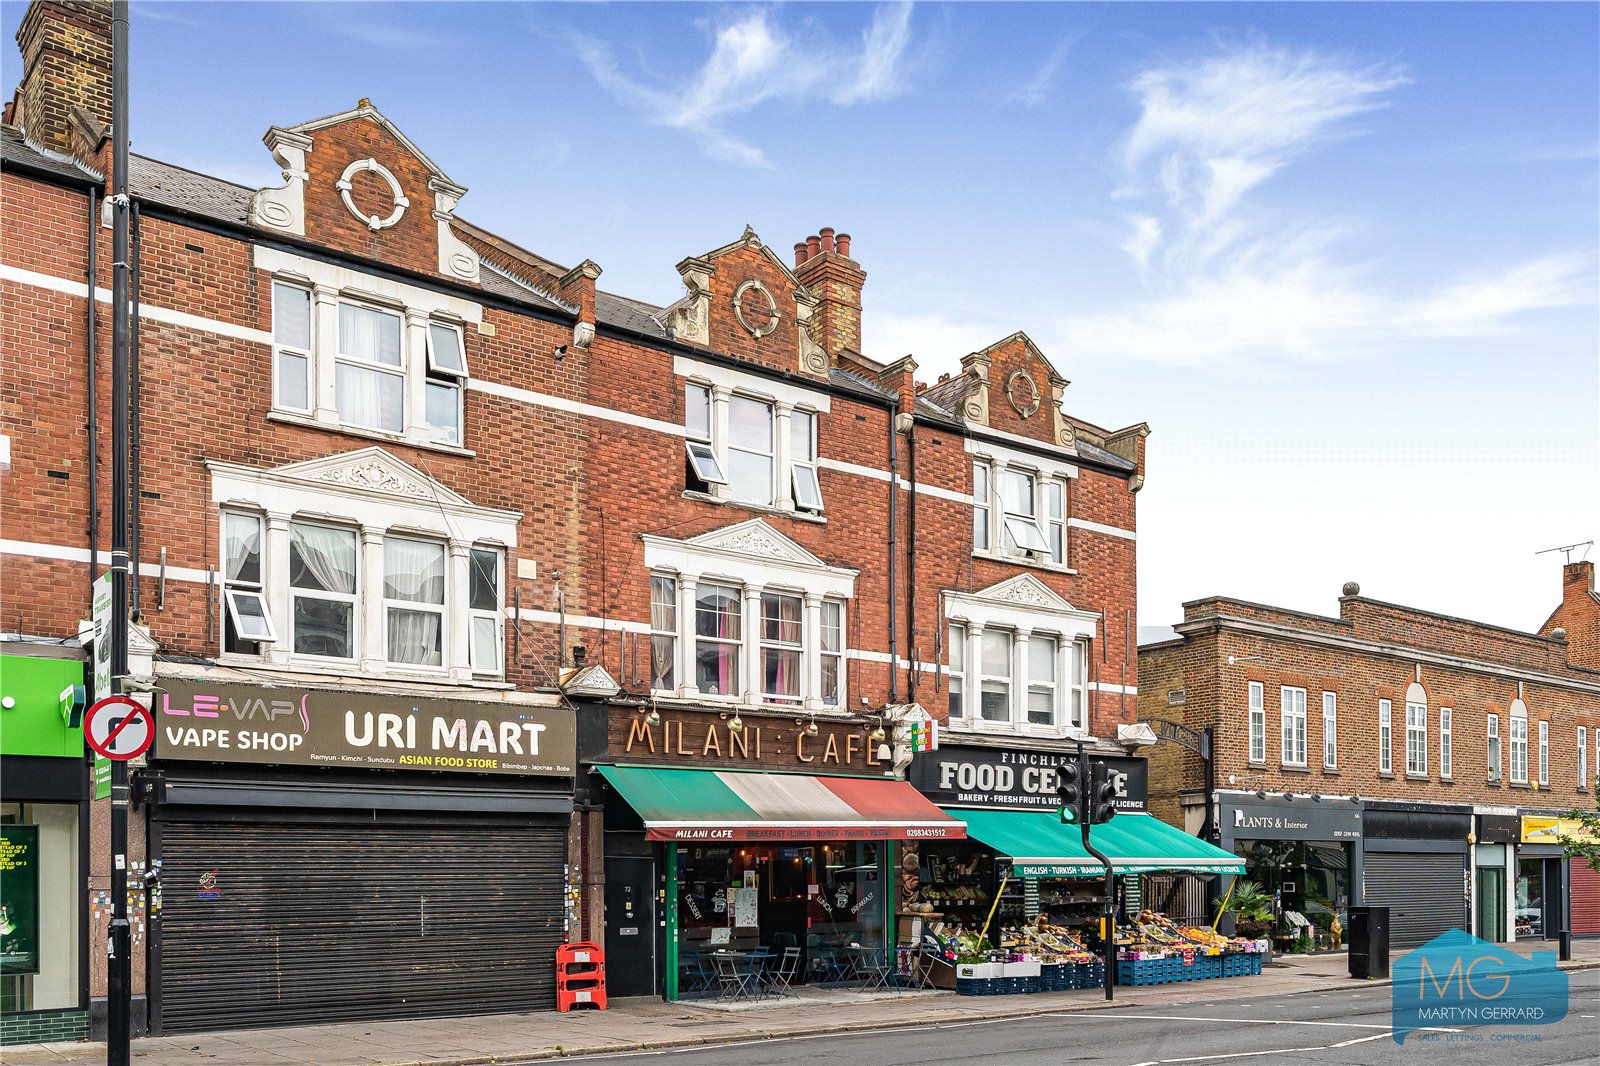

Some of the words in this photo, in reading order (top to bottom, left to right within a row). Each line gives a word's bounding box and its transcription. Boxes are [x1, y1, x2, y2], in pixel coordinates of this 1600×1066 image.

[166, 726, 231, 749] VAPE
[237, 730, 303, 752] SHOP
[345, 709, 417, 749] URI
[431, 716, 547, 756] MART
[626, 718, 761, 759] MILANI
[796, 730, 881, 766] CAFE
[310, 753, 337, 763] Ramyun
[367, 756, 395, 764] Sundubu
[399, 755, 432, 765] ASIAN
[435, 757, 464, 767] FOOD
[466, 758, 498, 769] STORE
[501, 762, 528, 771] Bibimbap
[939, 761, 1015, 793] FOOD
[1021, 767, 1128, 798] CEE
[957, 793, 989, 803] BAKERY
[1115, 800, 1145, 809] LICENCE
[1233, 809, 1273, 828] PLANTS
[1275, 817, 1281, 828] &
[1284, 818, 1308, 829] Interior
[675, 830, 708, 838] MILANI
[710, 829, 733, 838] CAFE
[747, 829, 785, 838] BREAKFAST
[790, 829, 812, 838] LUNCH
[906, 829, 946, 837] 02083431512
[685, 893, 702, 920] DESSERT
[816, 895, 833, 913] LUNCH
[850, 892, 874, 914] BREAKFAST
